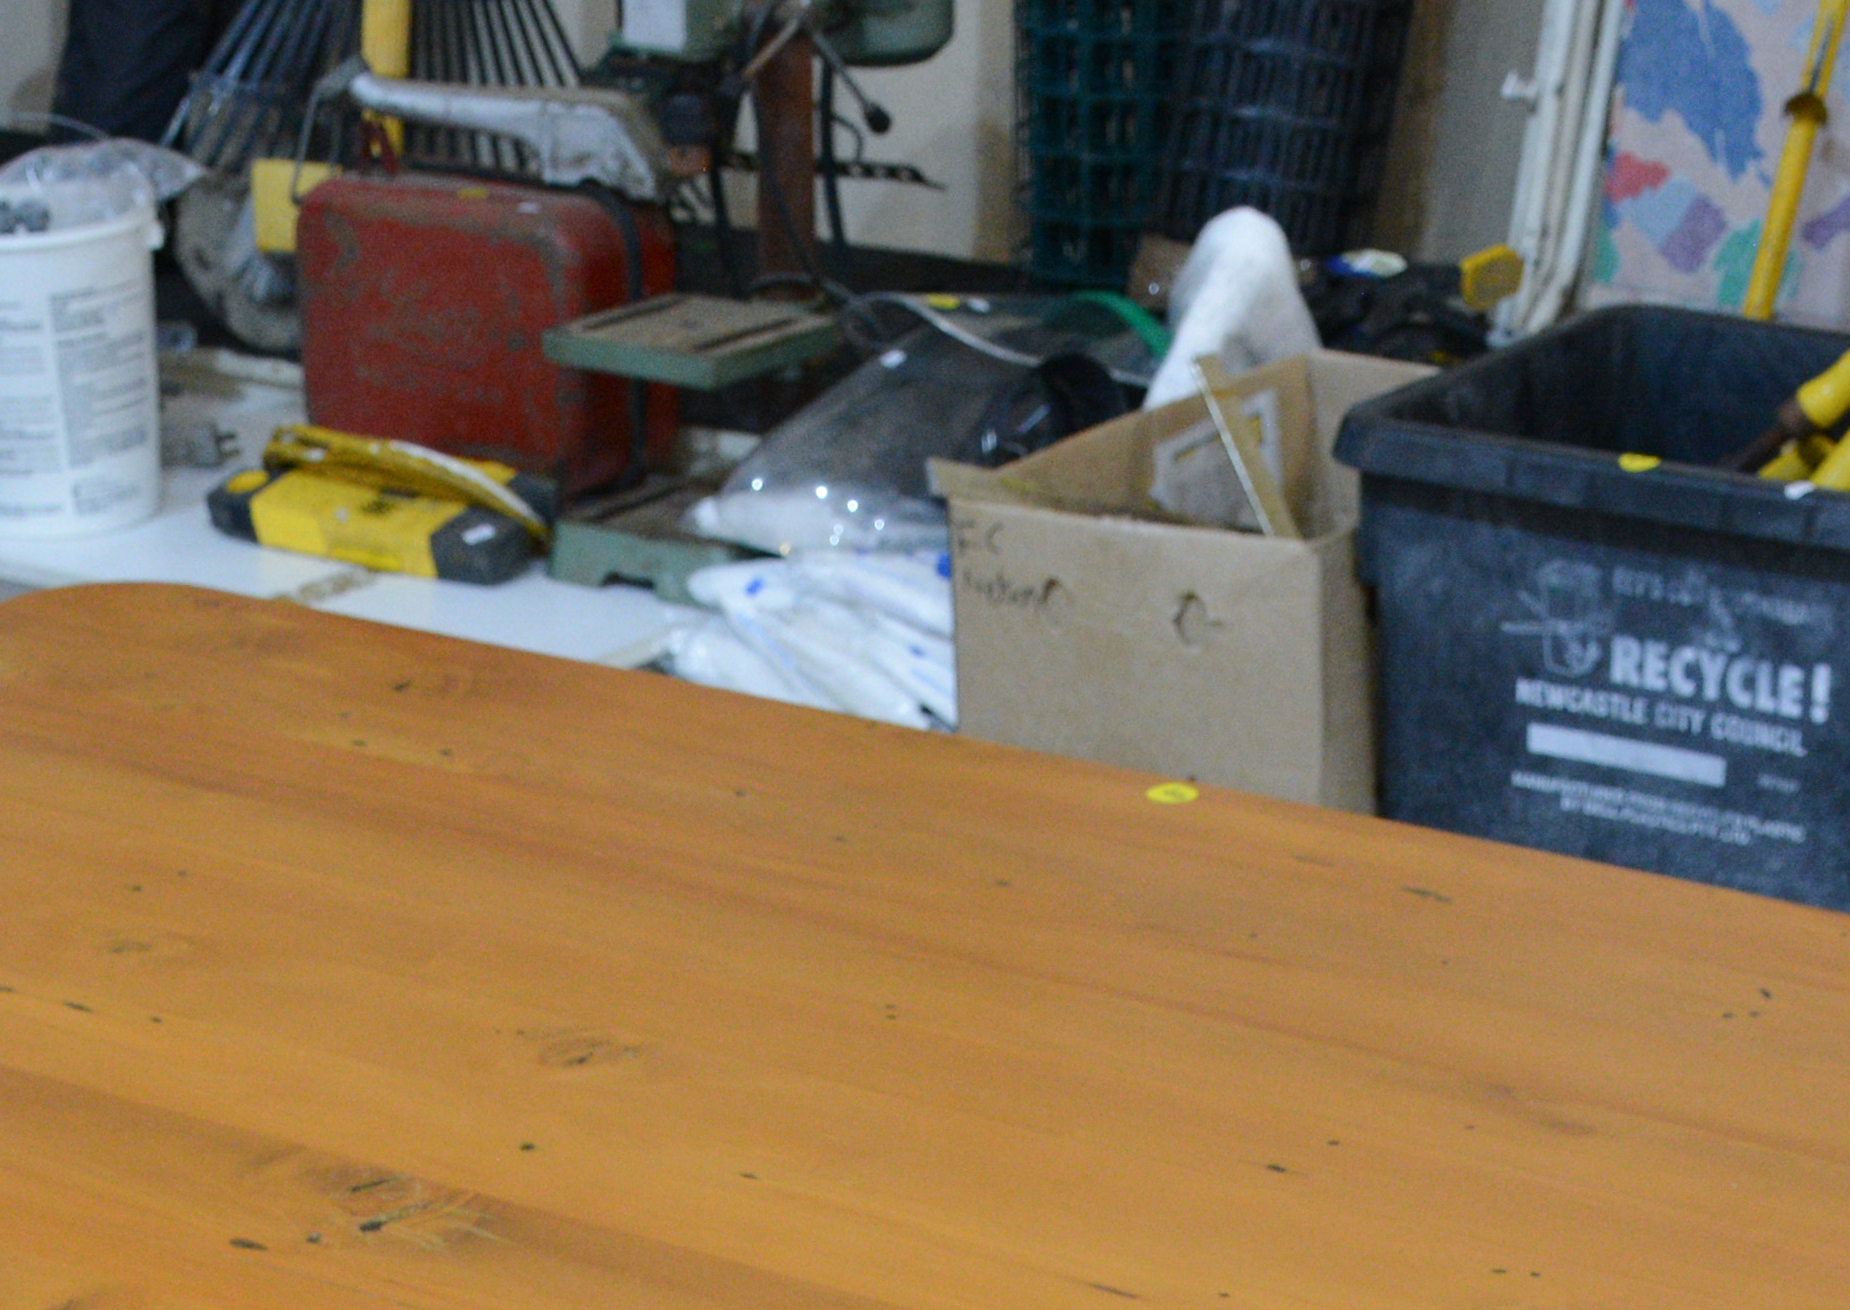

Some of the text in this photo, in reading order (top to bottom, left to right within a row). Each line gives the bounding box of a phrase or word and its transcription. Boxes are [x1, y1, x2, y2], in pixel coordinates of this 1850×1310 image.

[1514, 676, 1808, 758] NEWCASTLE CITY COUNCIL
[1609, 634, 1833, 725] RECYCLE!
